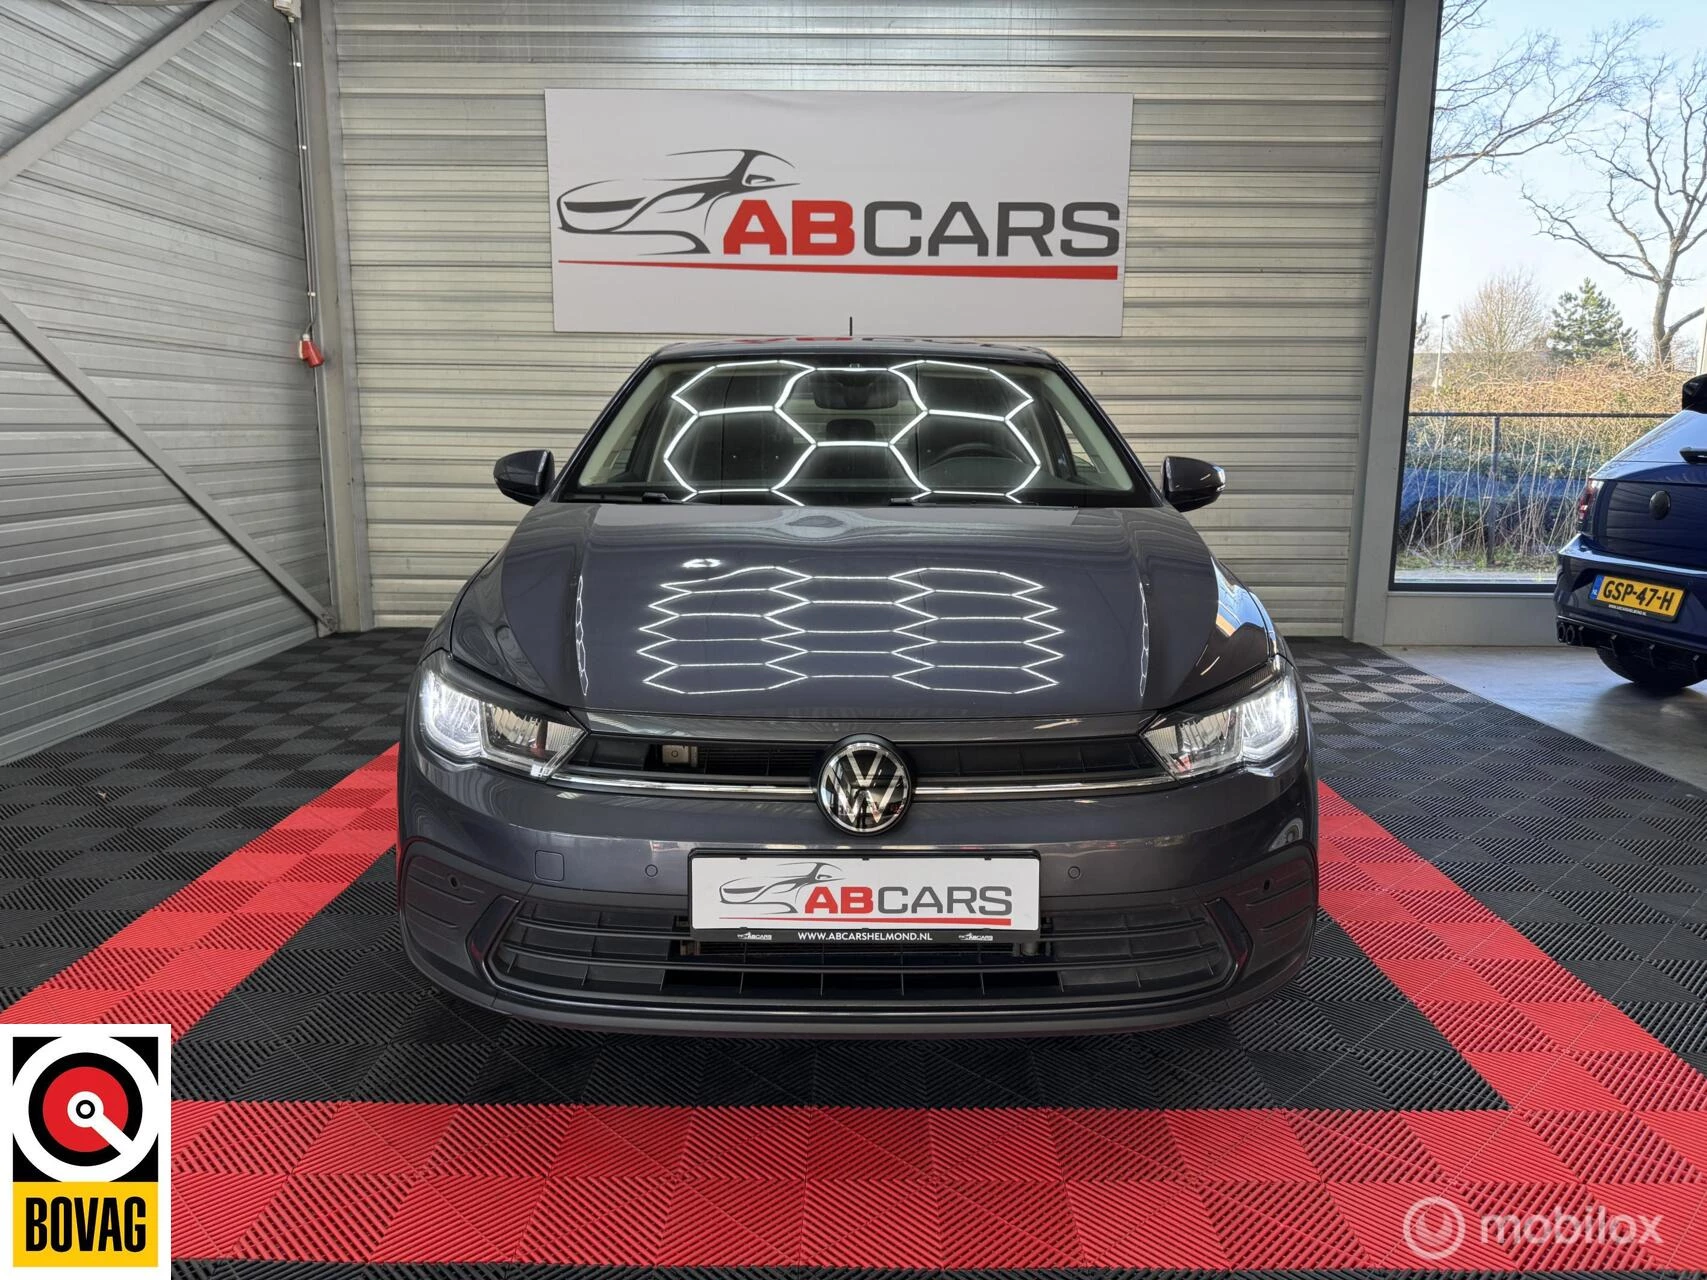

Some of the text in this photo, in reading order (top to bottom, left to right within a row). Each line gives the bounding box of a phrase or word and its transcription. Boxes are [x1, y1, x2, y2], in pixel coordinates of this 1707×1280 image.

[722, 199, 1121, 257] ABCARS
[1602, 580, 1675, 612] GSP-47-H
[804, 885, 1012, 916] ABCARS
[797, 931, 933, 941] WWW.ABCARSHELMOND.NL
